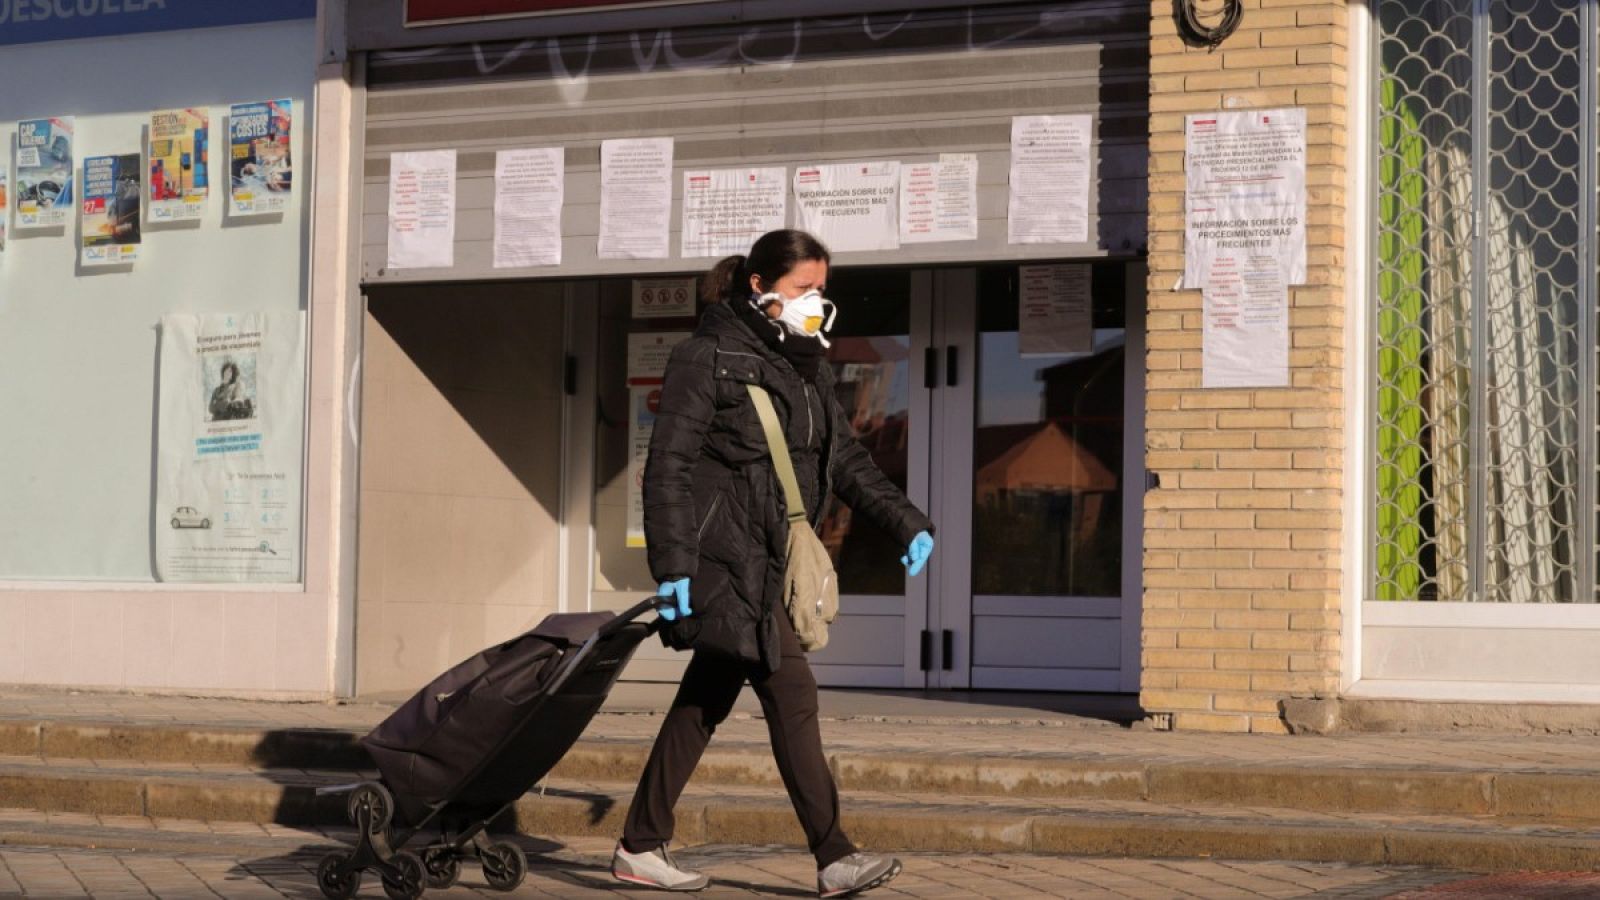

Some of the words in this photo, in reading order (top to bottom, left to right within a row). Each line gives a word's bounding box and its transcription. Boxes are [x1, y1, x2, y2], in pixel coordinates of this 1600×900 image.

[20, 124, 36, 137] CAP
[851, 187, 877, 196] SOBRE
[879, 186, 894, 194] LOS
[84, 201, 95, 214] 27
[804, 198, 870, 208] PROCEDIMIENTOS
[821, 208, 870, 216] FRECUENTES
[1192, 219, 1248, 229] INFORMACIÓN
[1251, 217, 1278, 226] SOBRE
[1281, 217, 1298, 225] LOS
[1198, 228, 1271, 239] PROCEDIMIENTOS
[1217, 240, 1271, 249] FRECUENTES
